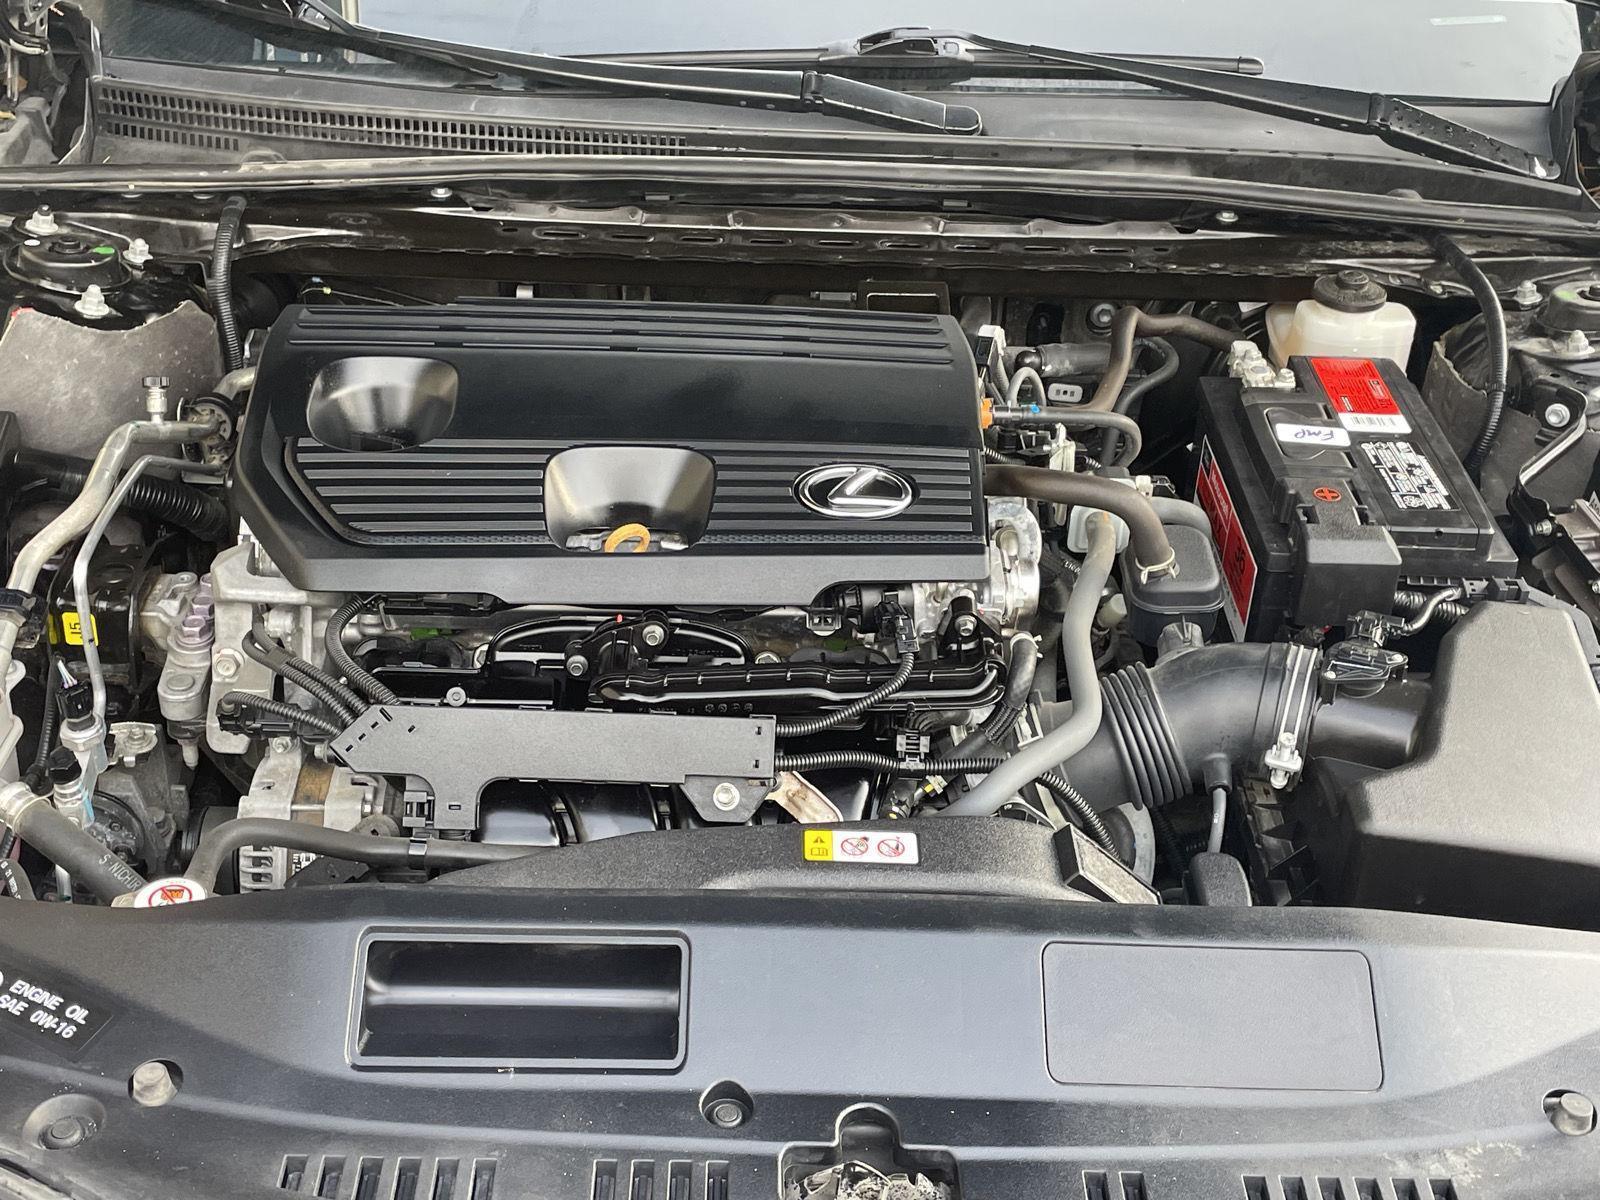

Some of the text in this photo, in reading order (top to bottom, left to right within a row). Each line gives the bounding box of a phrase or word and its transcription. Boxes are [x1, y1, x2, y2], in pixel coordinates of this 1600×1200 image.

[0, 994, 77, 1039] SAE 0W-16
[9, 979, 89, 1025] ENGINE OIL
